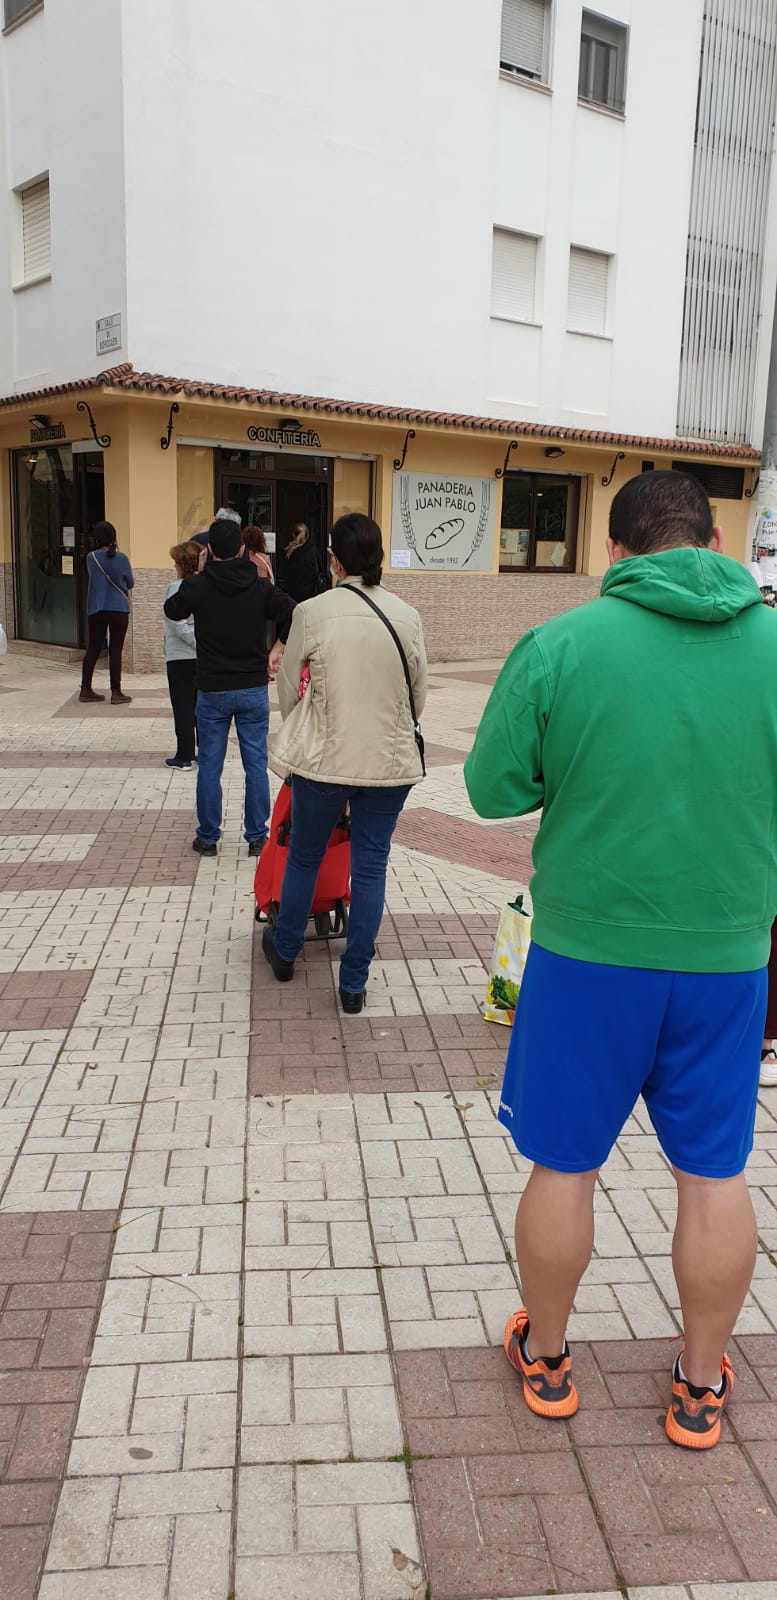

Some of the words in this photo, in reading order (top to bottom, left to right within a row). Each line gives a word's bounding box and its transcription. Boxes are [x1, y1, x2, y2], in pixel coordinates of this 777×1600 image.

[247, 426, 321, 447] CONFITERÍA
[417, 482, 474, 497] PANADERIA
[415, 497, 442, 510] JUAN
[445, 497, 476, 512] PABLO
